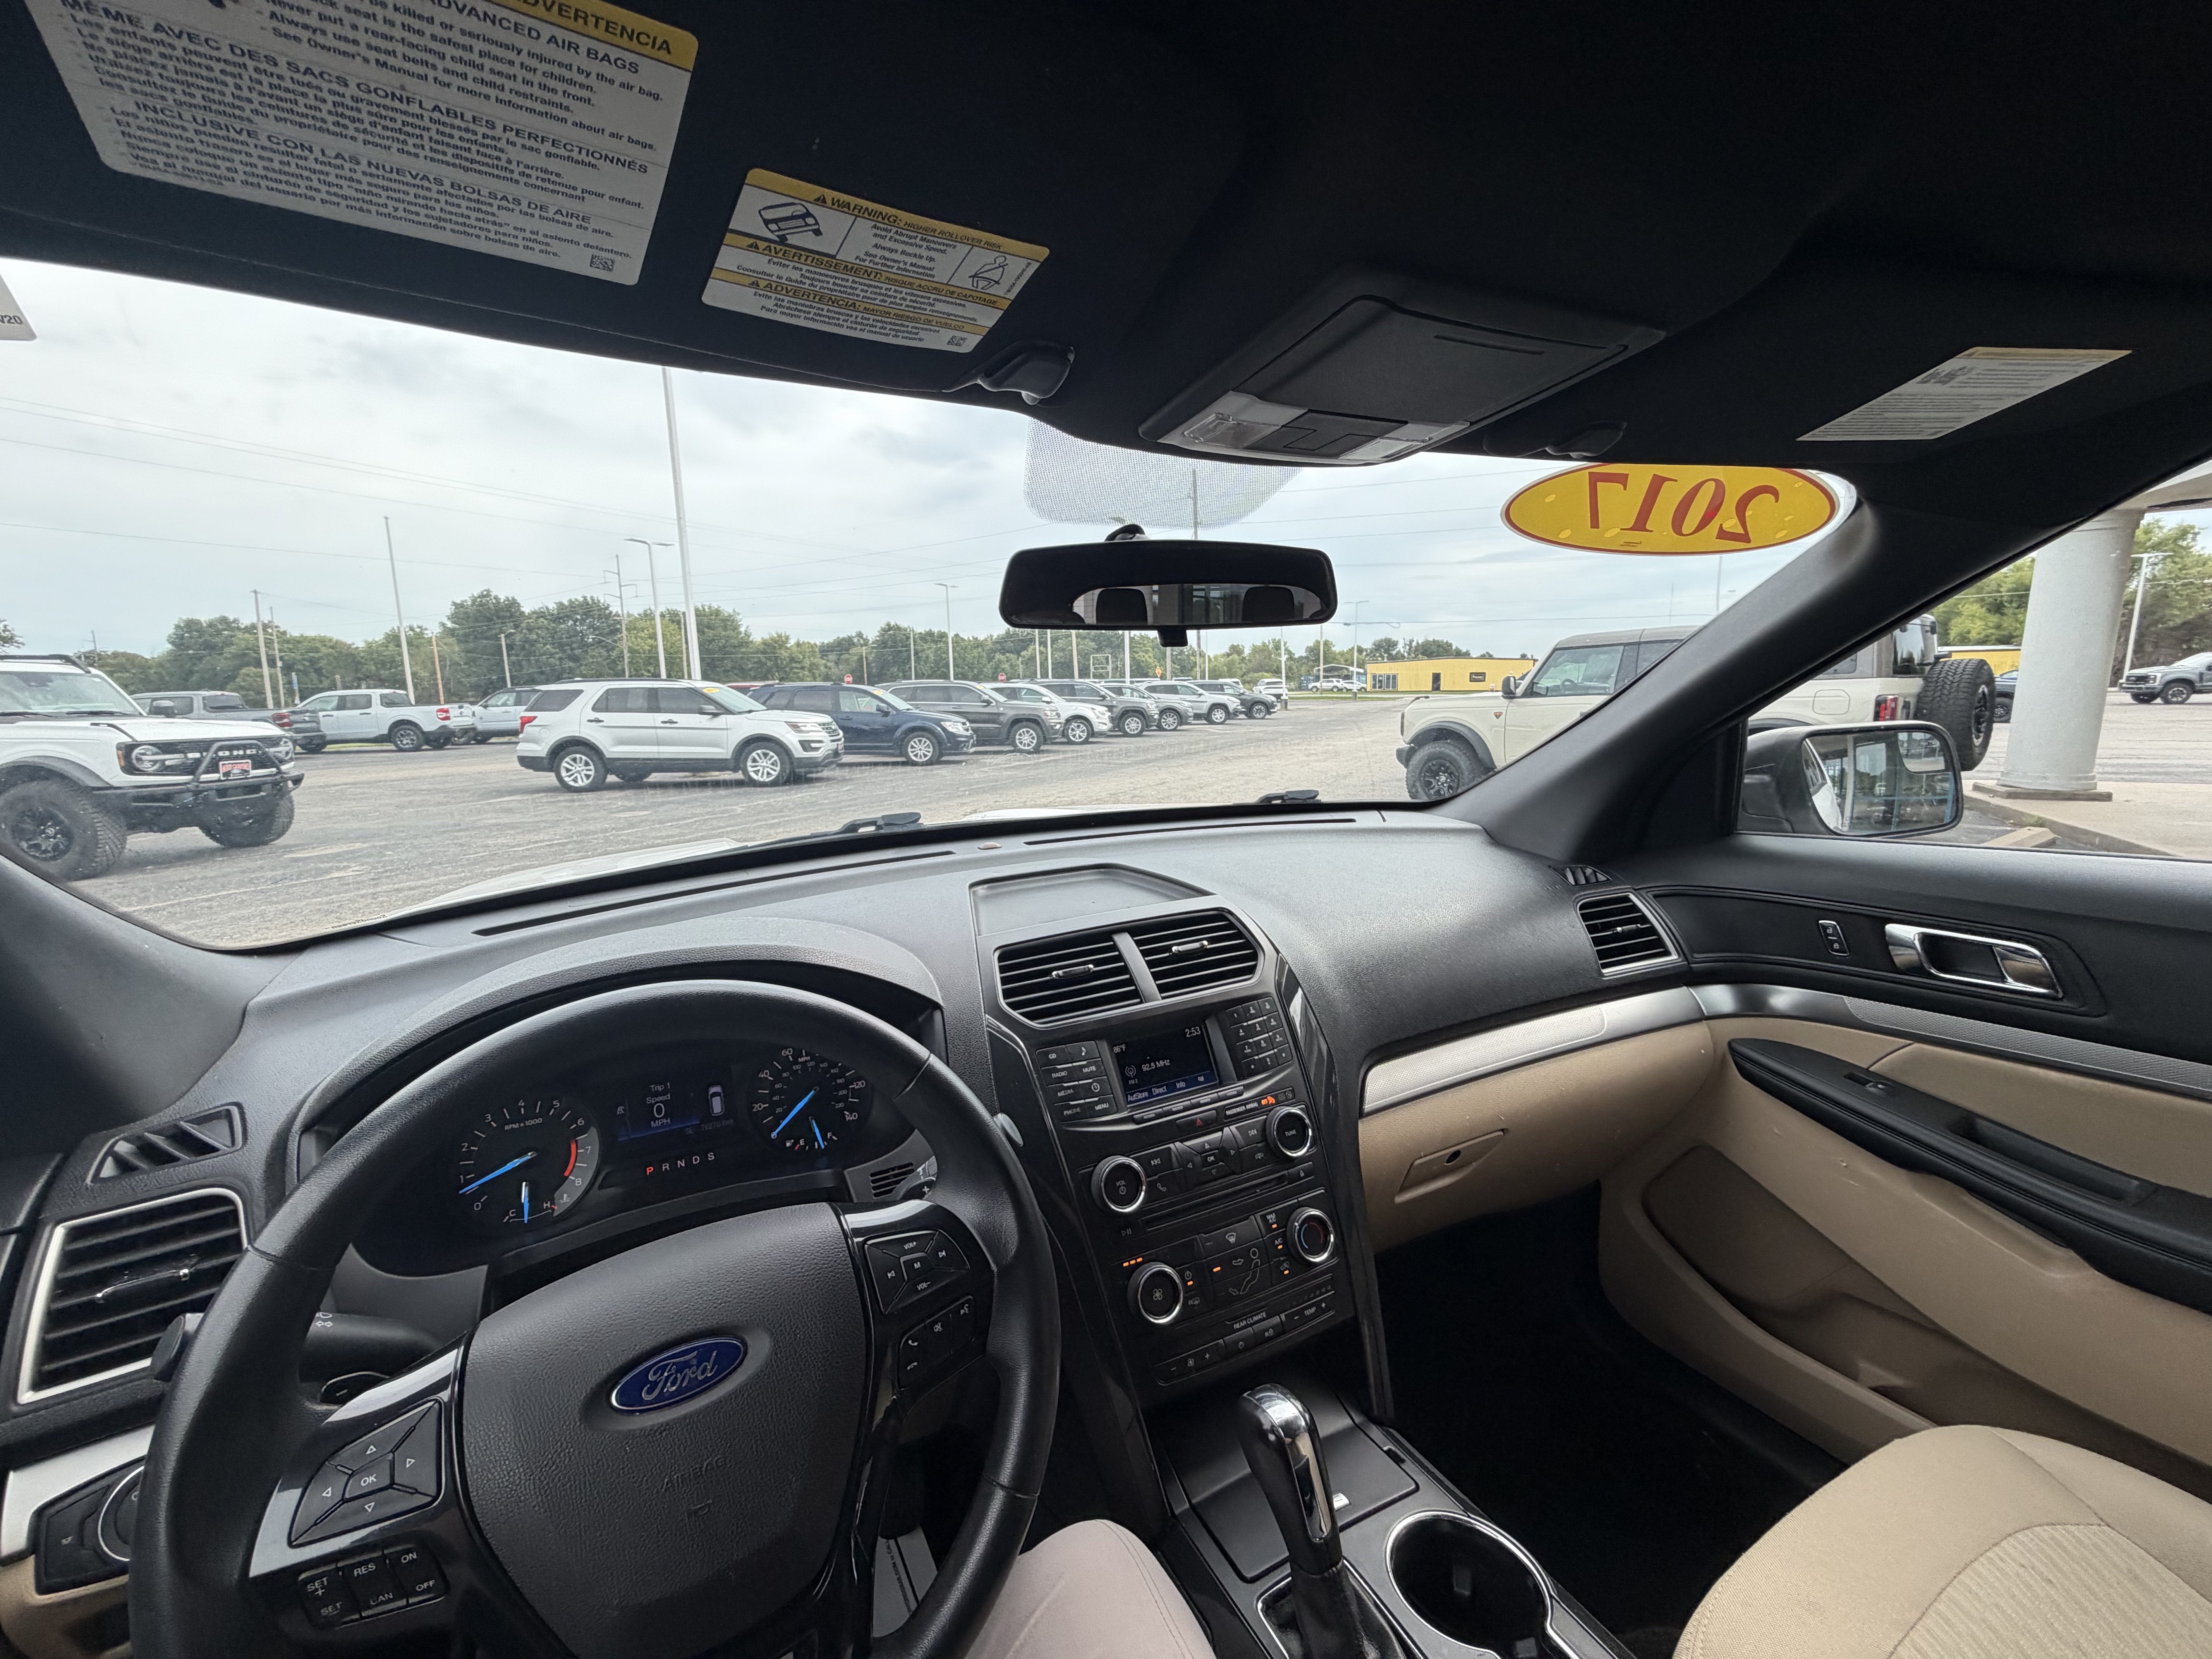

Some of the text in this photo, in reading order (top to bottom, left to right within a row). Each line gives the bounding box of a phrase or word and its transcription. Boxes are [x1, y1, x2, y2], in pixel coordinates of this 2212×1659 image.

[343, 3, 598, 94] seat the safest place for children.
[392, 2, 664, 102] killed or seriously injured by the air bag.
[546, 33, 580, 55] AIR
[586, 46, 640, 75] BAGS
[267, 9, 574, 113] Always use seat belts and child restraints.
[364, 26, 595, 107] rear-facing child seat in the front.
[271, 26, 658, 152] See Owner's Manual for more information about air bags.
[151, 21, 222, 51] AVEC
[228, 43, 280, 67] DES
[285, 60, 349, 87] SACS
[356, 81, 496, 130] GONFLABLES
[502, 124, 649, 173] PERFECTIONNÉS
[134, 100, 591, 223] INCLUSIVE CON LAS NUEVAS BOLSAS DE AIRE
[828, 198, 904, 225] WARNING:
[935, 228, 983, 246] ROLLOVER
[982, 240, 1003, 249] RISK
[870, 223, 957, 249] Avoid Abrupt Maneuvers
[871, 242, 900, 254] Always
[899, 250, 925, 260] Buckle
[888, 235, 924, 249] Excessive
[924, 244, 948, 255] Speed.
[866, 259, 896, 270] Further
[878, 254, 909, 266] Owner's
[908, 261, 935, 271] Manual
[761, 244, 884, 280] AVERTISSEMENT:
[883, 276, 915, 287] RISQUE
[916, 283, 945, 293] ACCRU
[956, 292, 998, 305] CAPOTAGE
[762, 282, 862, 310] ADVERTENCIA:
[862, 306, 892, 316] MAYOR
[1185, 1026, 1201, 1038] 2:53
[782, 1048, 793, 1056] 60
[1082, 1065, 1097, 1073] MUTE
[1141, 1059, 1171, 1072] 92.5 MHz
[758, 1070, 770, 1078] 40
[1051, 1070, 1068, 1079] RADIO
[650, 1084, 664, 1092] Trip
[853, 1080, 866, 1089] 120
[1057, 1089, 1074, 1097] MEDIA
[1127, 1080, 1187, 1103] AutStore Direct Info
[646, 1093, 670, 1104] Speed
[653, 1103, 665, 1118] 0
[752, 1103, 763, 1112] 20
[1063, 1106, 1081, 1116] PHONE
[1094, 1102, 1109, 1111] MENU
[1225, 1106, 1246, 1116] PASSENGER
[1245, 1102, 1259, 1110] AIRBAG
[651, 1118, 670, 1128] MPH
[845, 1113, 858, 1121] 140
[505, 1122, 519, 1130] RPM
[525, 1118, 543, 1126] 1000
[1285, 1129, 1297, 1137] TUNE
[462, 1143, 468, 1151] 2
[646, 1152, 715, 1175] P R N D S
[460, 1175, 464, 1183] 1
[575, 1178, 582, 1186] 8
[474, 1202, 481, 1210] 0
[1274, 1237, 1283, 1246] A/C
[1304, 1307, 1316, 1316] TEMP
[1233, 1311, 1267, 1330] REAR CLIMATE
[642, 1350, 717, 1400] Ford
[361, 1474, 376, 1486] OK
[400, 1551, 418, 1564] ON
[353, 1562, 376, 1577] RES
[307, 1576, 328, 1592] SET
[415, 1580, 435, 1592] OFF
[370, 1592, 393, 1606] CAN
[320, 1601, 342, 1616] SET
